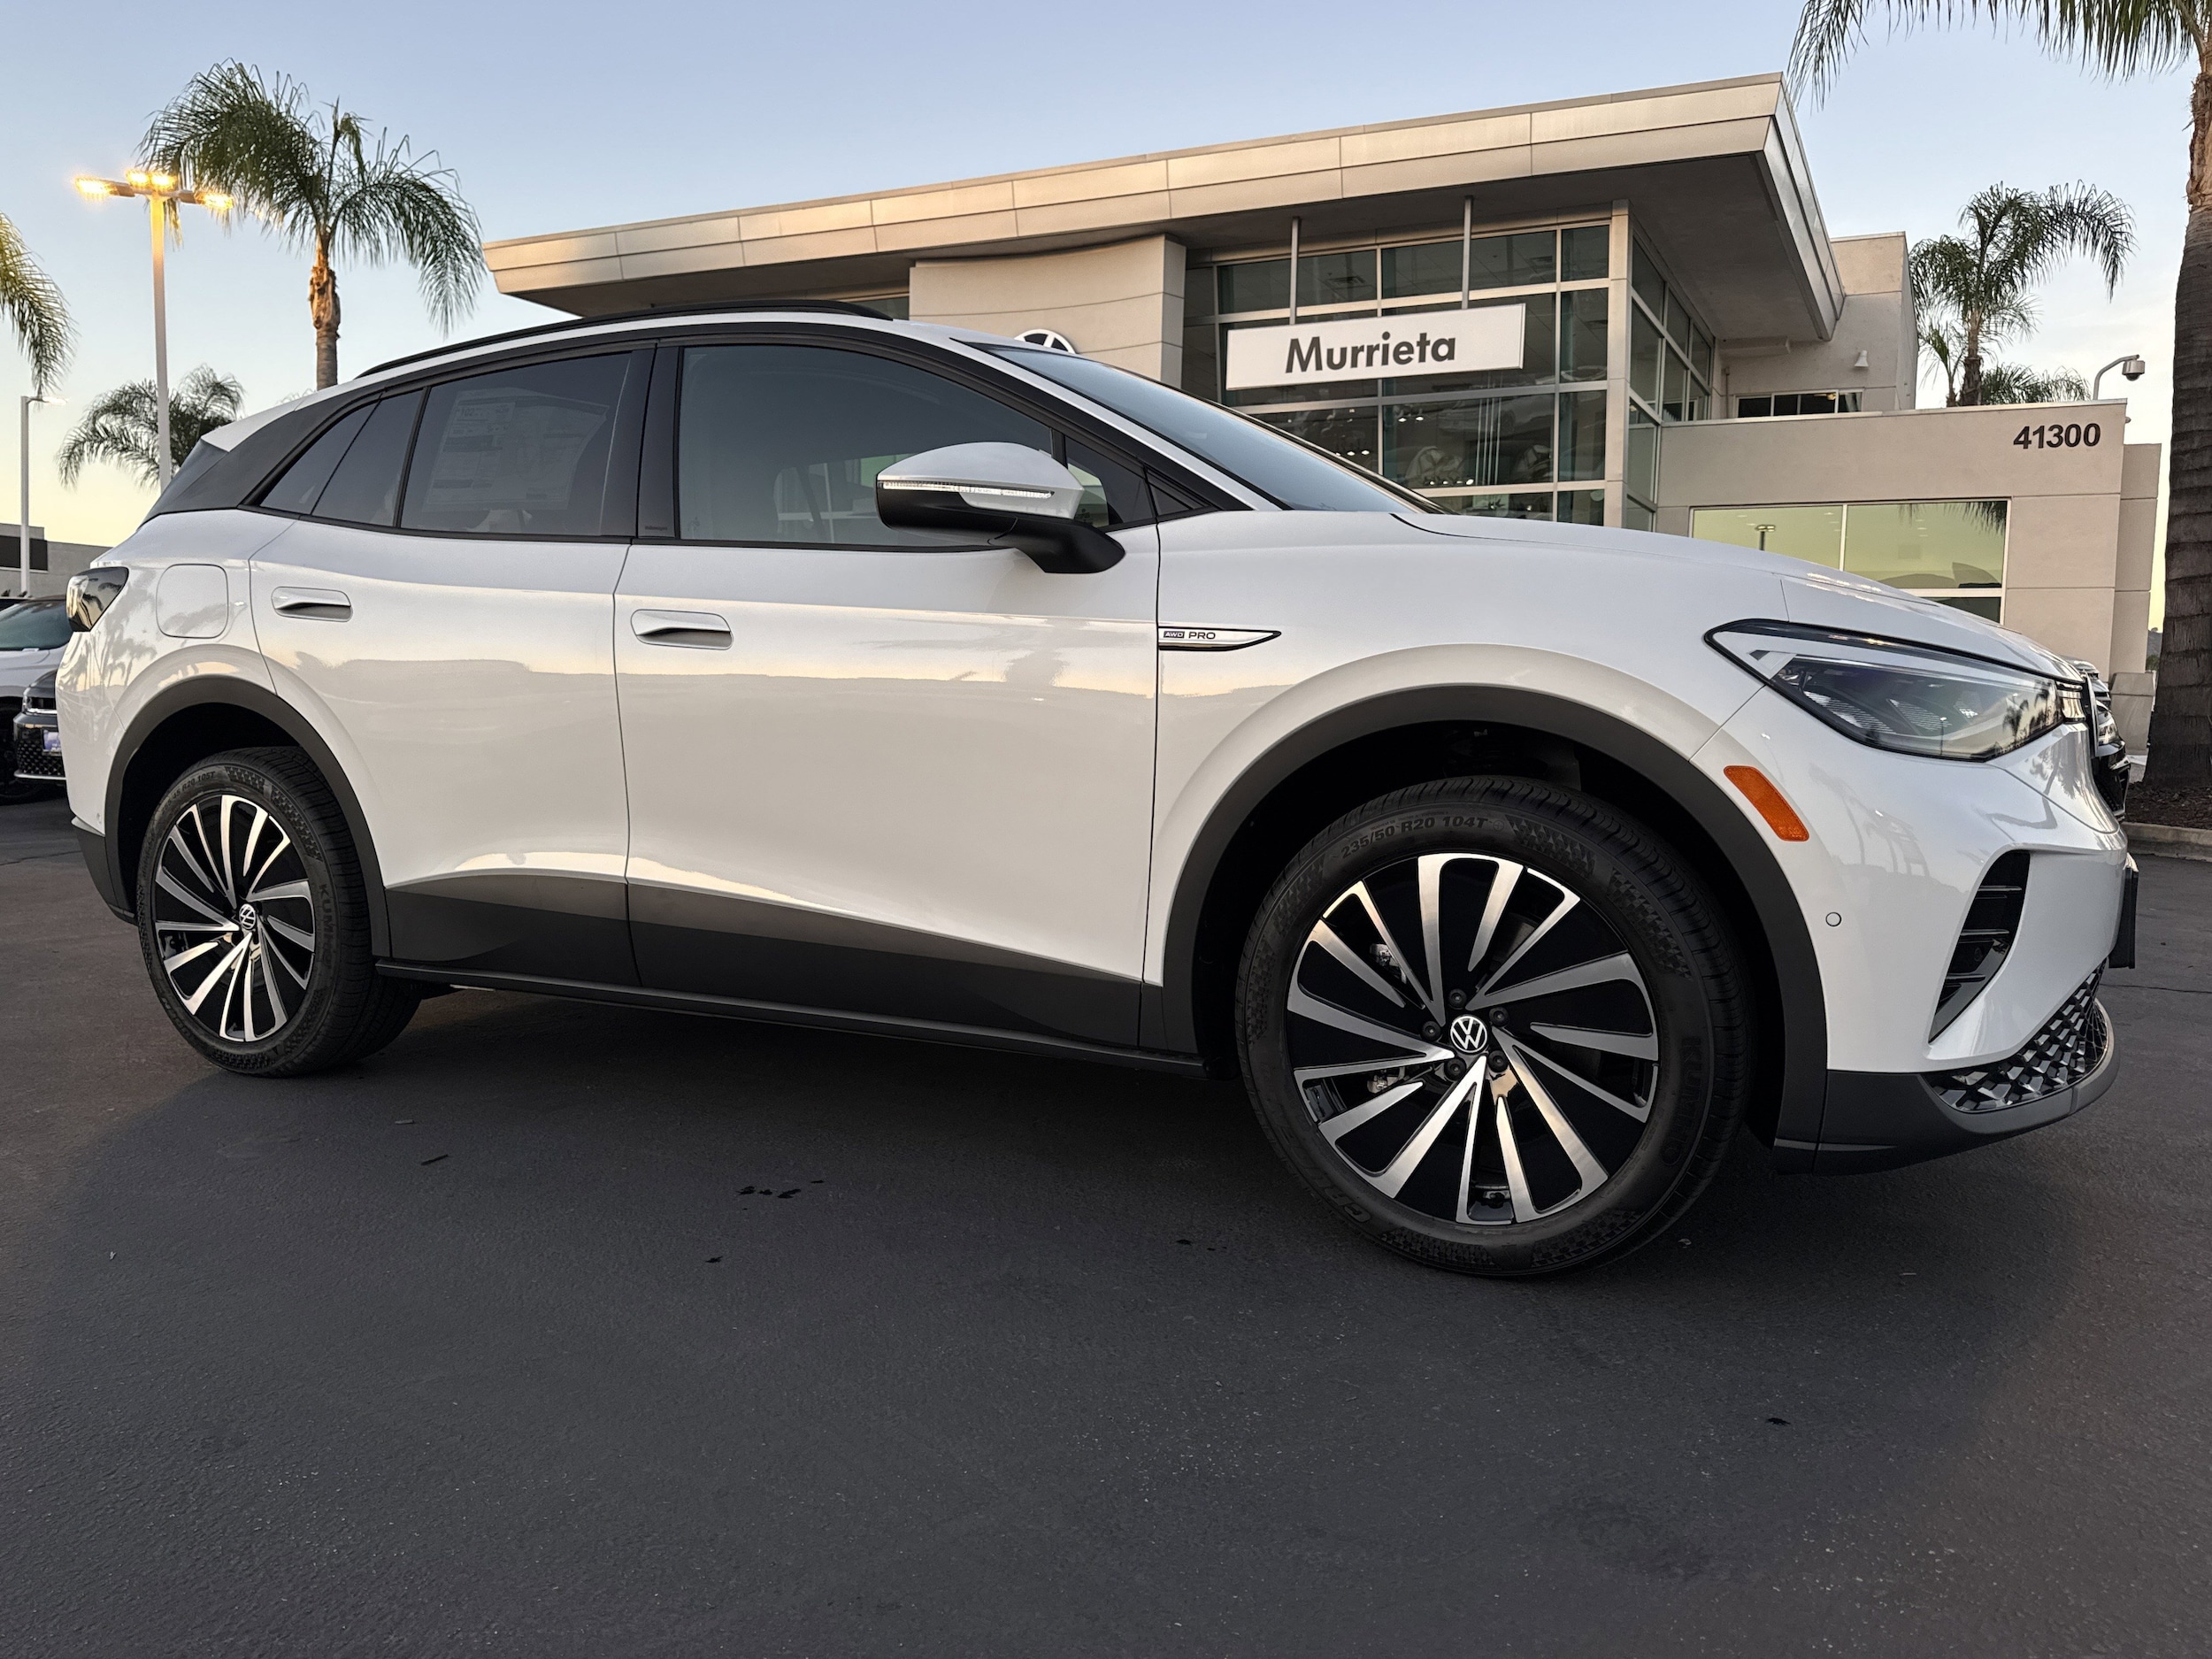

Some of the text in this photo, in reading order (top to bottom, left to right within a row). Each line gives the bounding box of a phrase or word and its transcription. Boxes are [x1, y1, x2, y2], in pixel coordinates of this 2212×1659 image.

[1285, 331, 1455, 373] Murrieta
[2013, 423, 2101, 449] 41300
[1341, 826, 1395, 858] 235/50
[1401, 817, 1435, 833] R20
[1443, 815, 1488, 828] 104T
